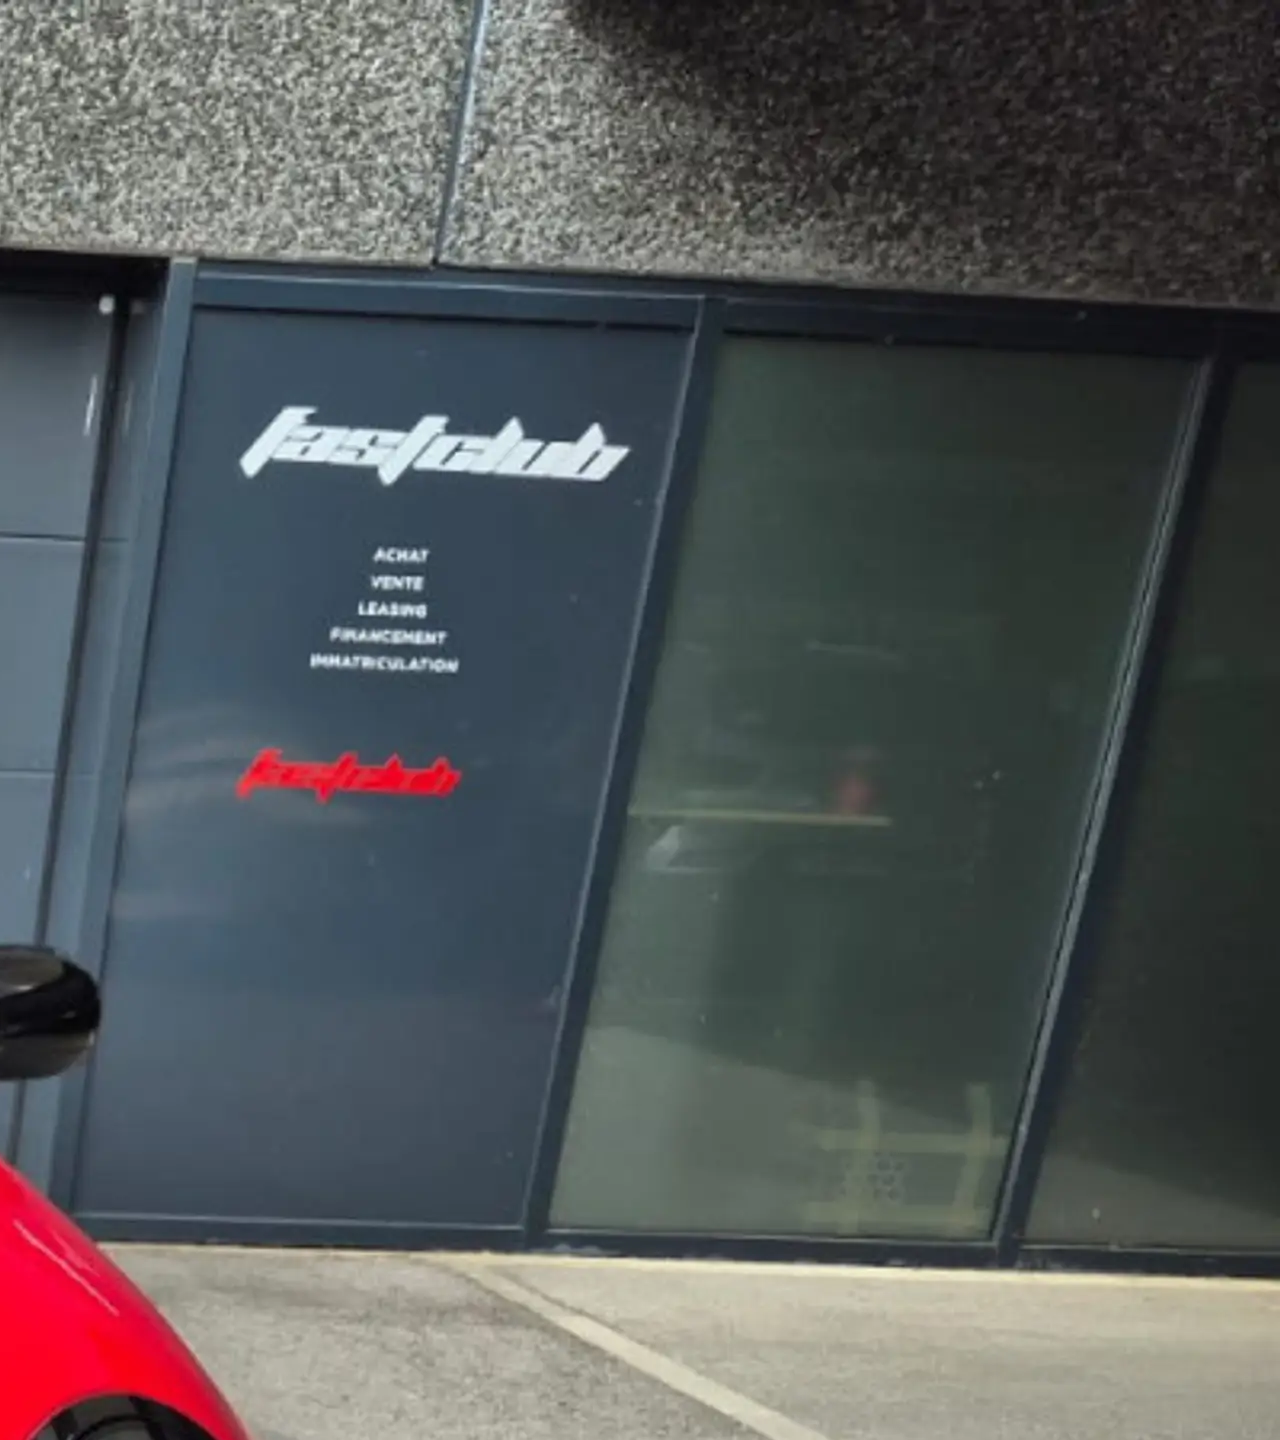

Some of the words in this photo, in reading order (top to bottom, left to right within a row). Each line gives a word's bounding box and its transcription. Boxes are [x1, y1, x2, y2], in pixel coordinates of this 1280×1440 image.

[373, 547, 429, 564] ACHAT
[370, 575, 425, 591] VENTE
[357, 601, 428, 619] LEASING
[329, 627, 448, 646] FINANCEMENT
[309, 653, 460, 673] IMMATRICULATION
